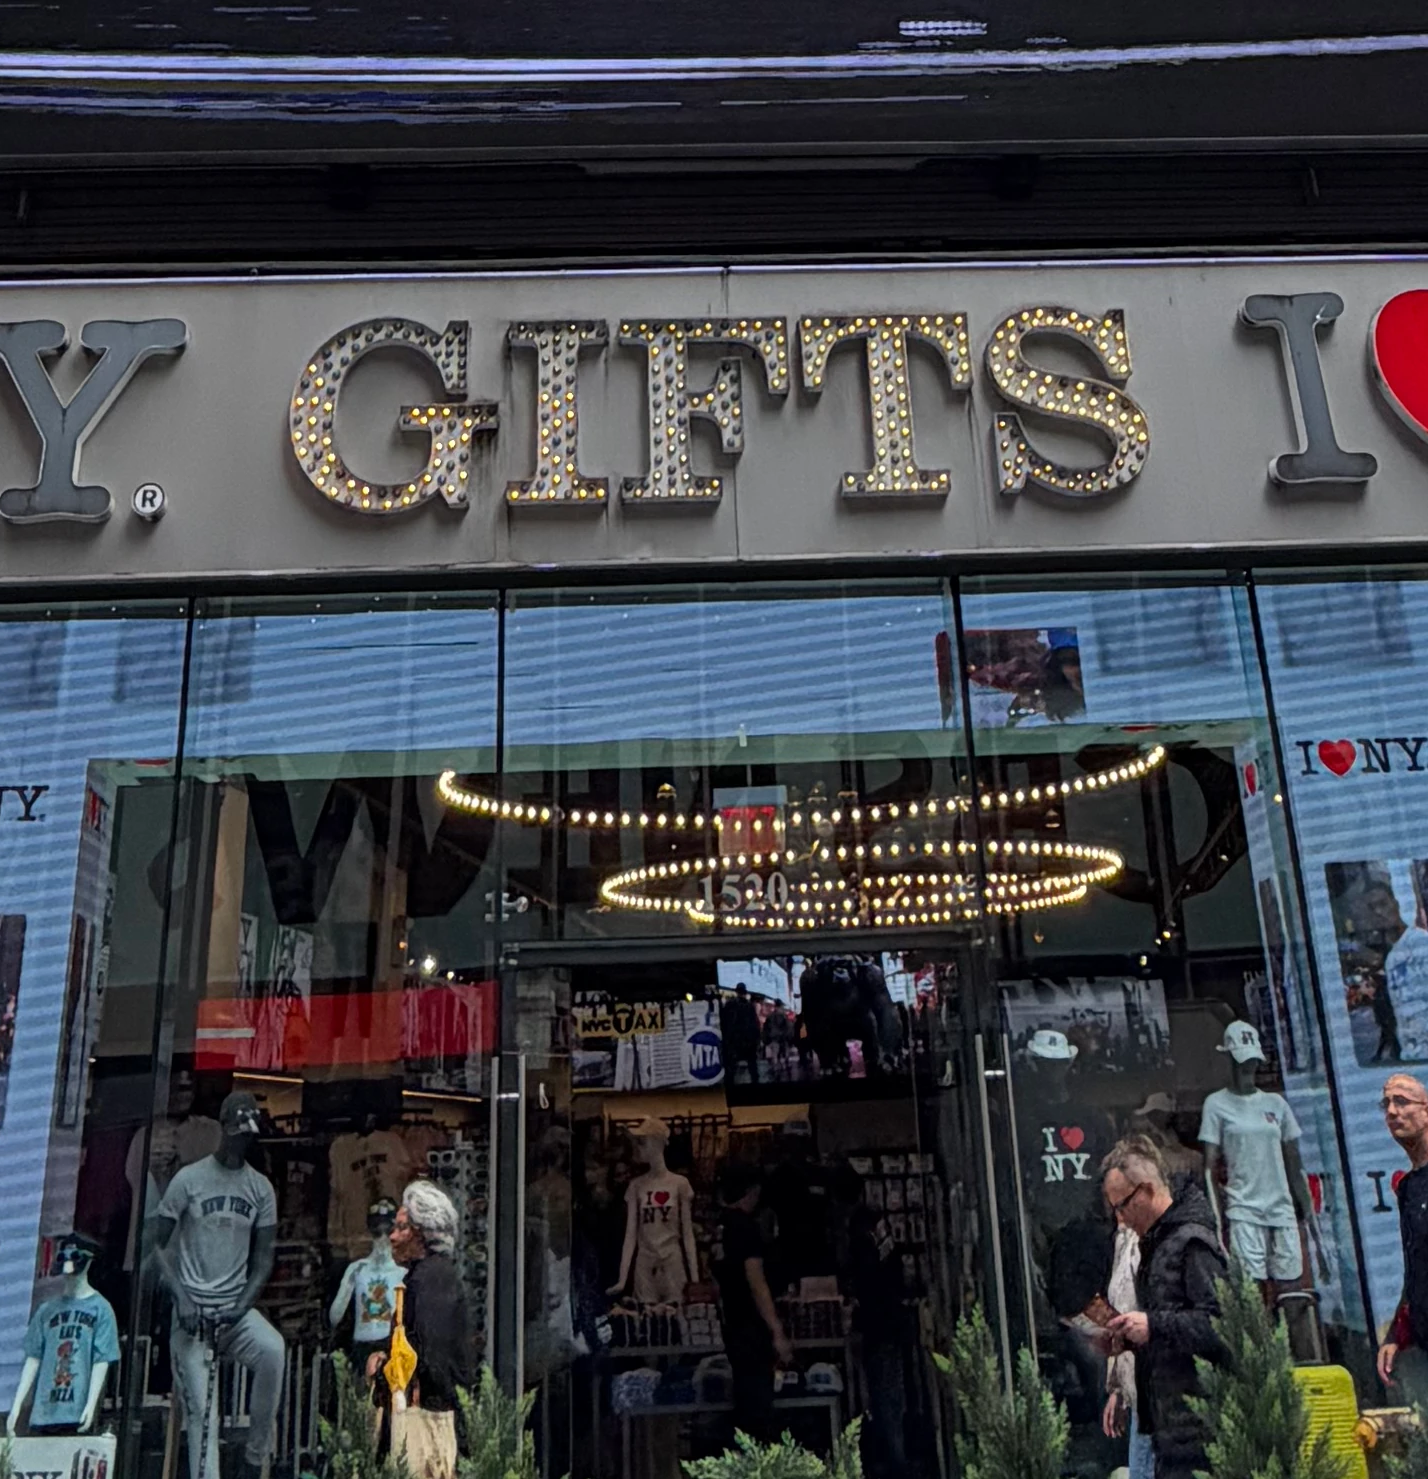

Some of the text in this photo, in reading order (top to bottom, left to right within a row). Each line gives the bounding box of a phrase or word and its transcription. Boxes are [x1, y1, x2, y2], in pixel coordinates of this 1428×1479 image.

[1236, 289, 1379, 487] I
[287, 304, 1153, 516] GIFTS
[1296, 736, 1428, 776] I NY
[700, 871, 789, 913] 1520
[687, 1045, 720, 1069] MTA
[1041, 1126, 1058, 1153] I
[1040, 1152, 1092, 1183] NY
[200, 1195, 254, 1218] NEW YORK
[1366, 1170, 1393, 1213] I
